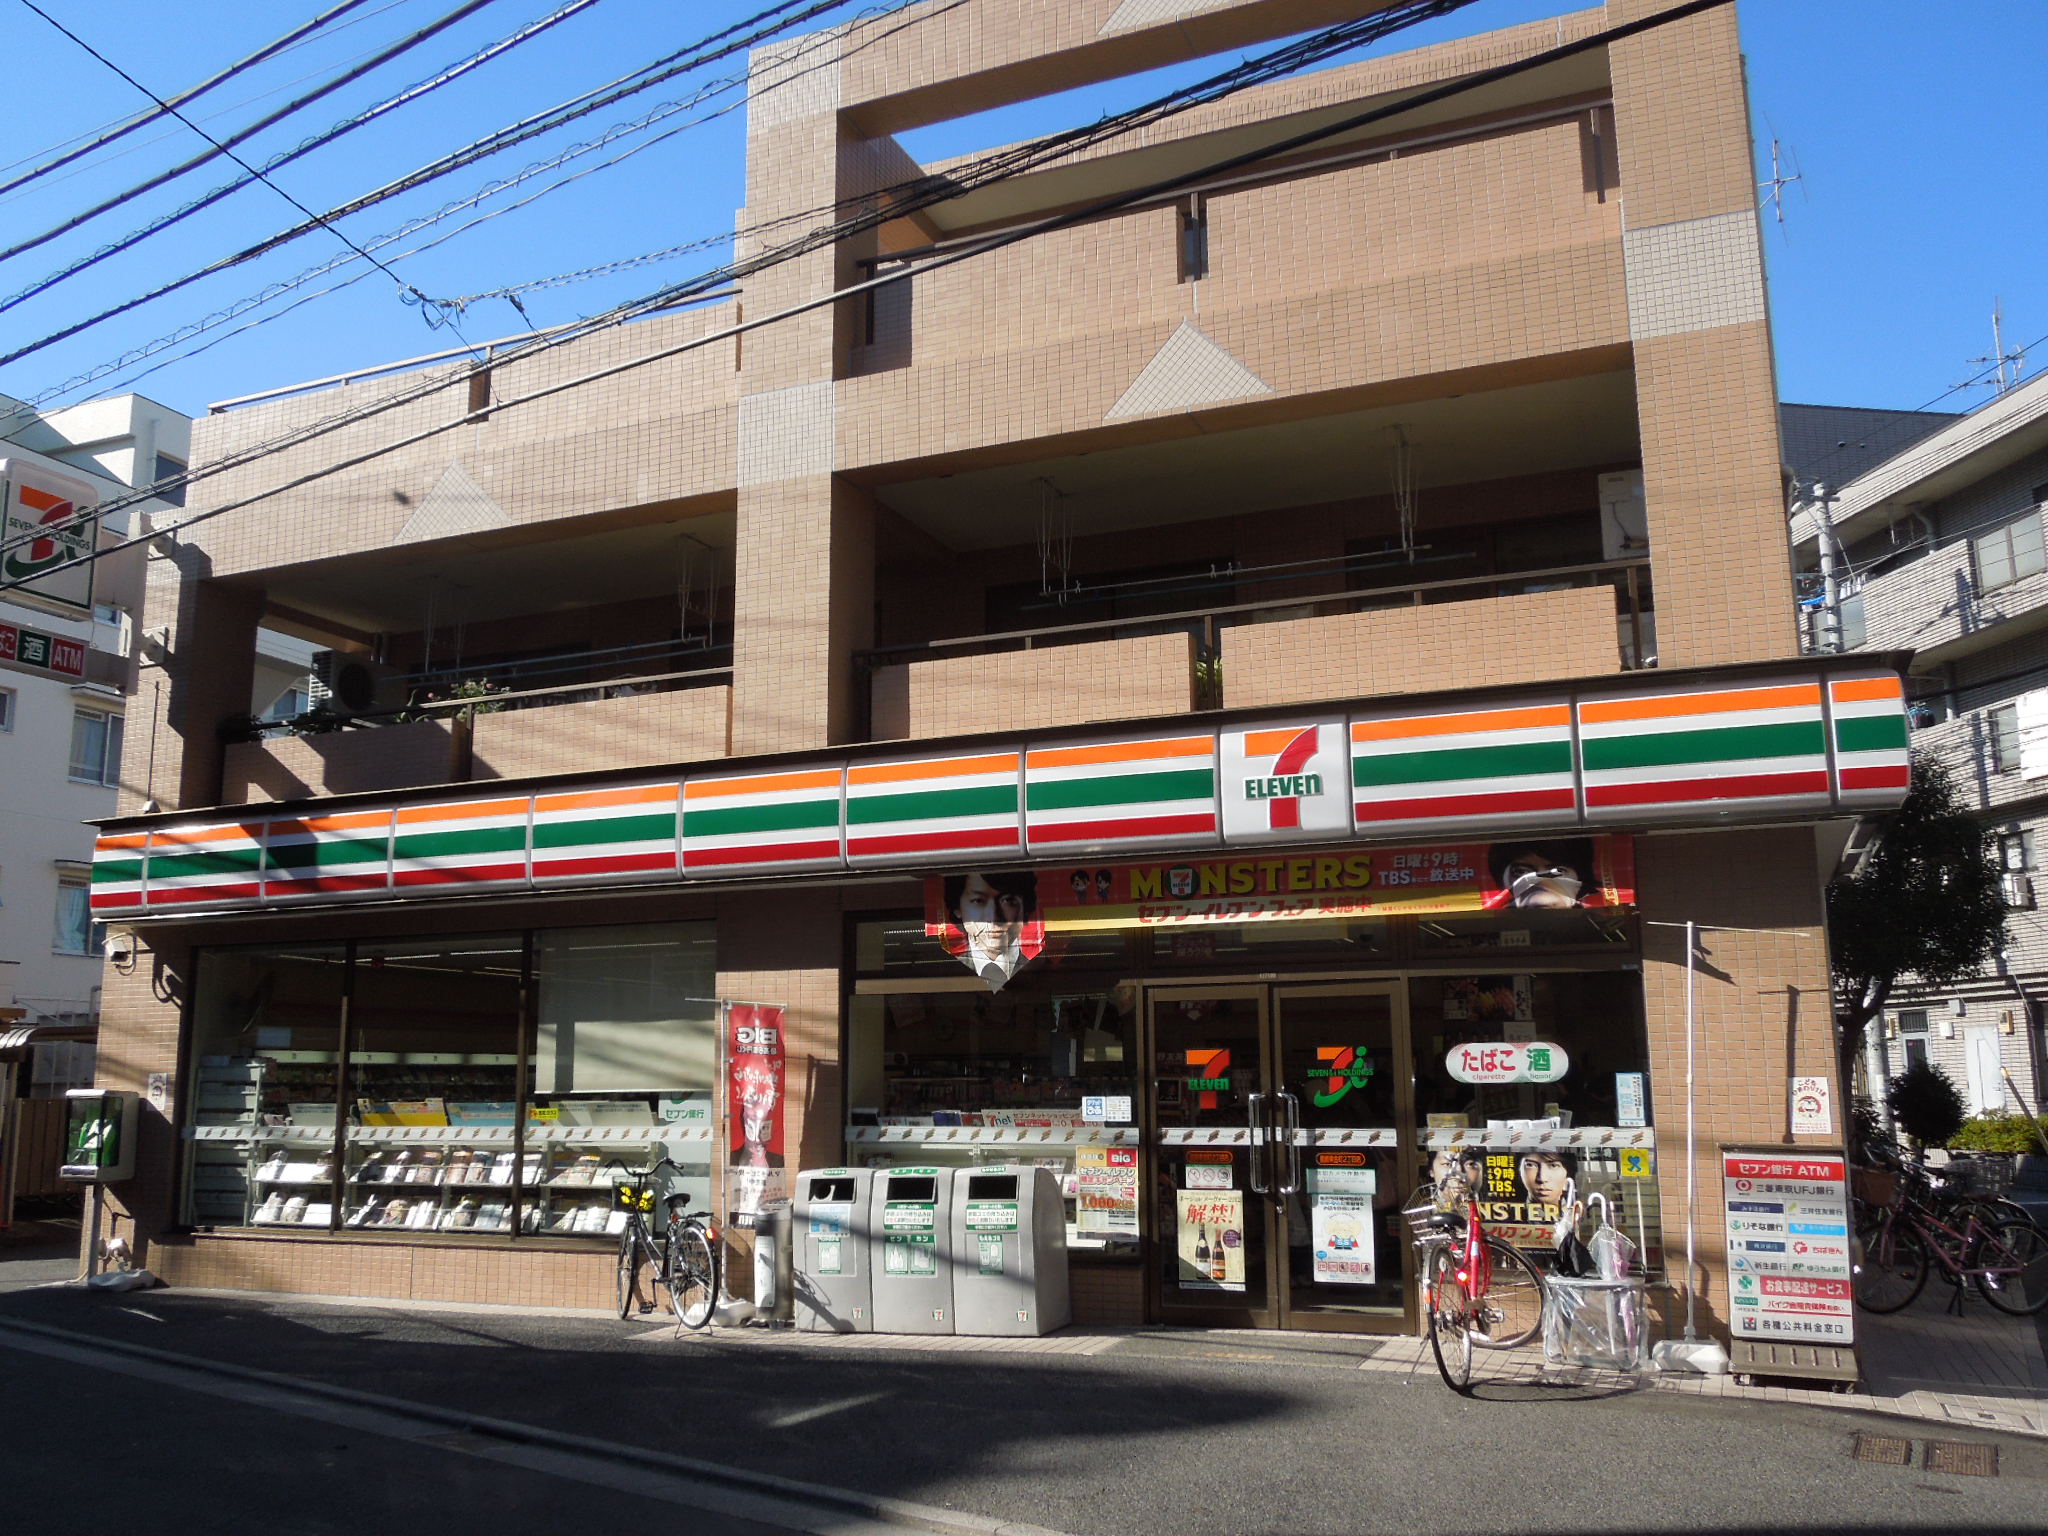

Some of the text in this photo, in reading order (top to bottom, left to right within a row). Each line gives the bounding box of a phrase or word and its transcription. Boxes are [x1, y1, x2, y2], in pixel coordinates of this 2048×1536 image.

[23, 636, 46, 662] 酒
[53, 644, 82, 671] ATM
[1319, 894, 1376, 914] 実施中
[1462, 1048, 1551, 1072] たばこ 酒
[665, 1109, 704, 1119] セブン銀行
[1739, 1163, 1830, 1177] セブン銀行 ATM
[1186, 1203, 1235, 1224] 解禁!
[1743, 1221, 1784, 1232] りそな銀行
[1754, 1260, 1787, 1271] 新生銀行
[1806, 1264, 1846, 1274] ゆうちょ銀行
[1765, 1279, 1845, 1296] お食事配達サービス
[1762, 1319, 1844, 1335] 各種公共料金窓口
